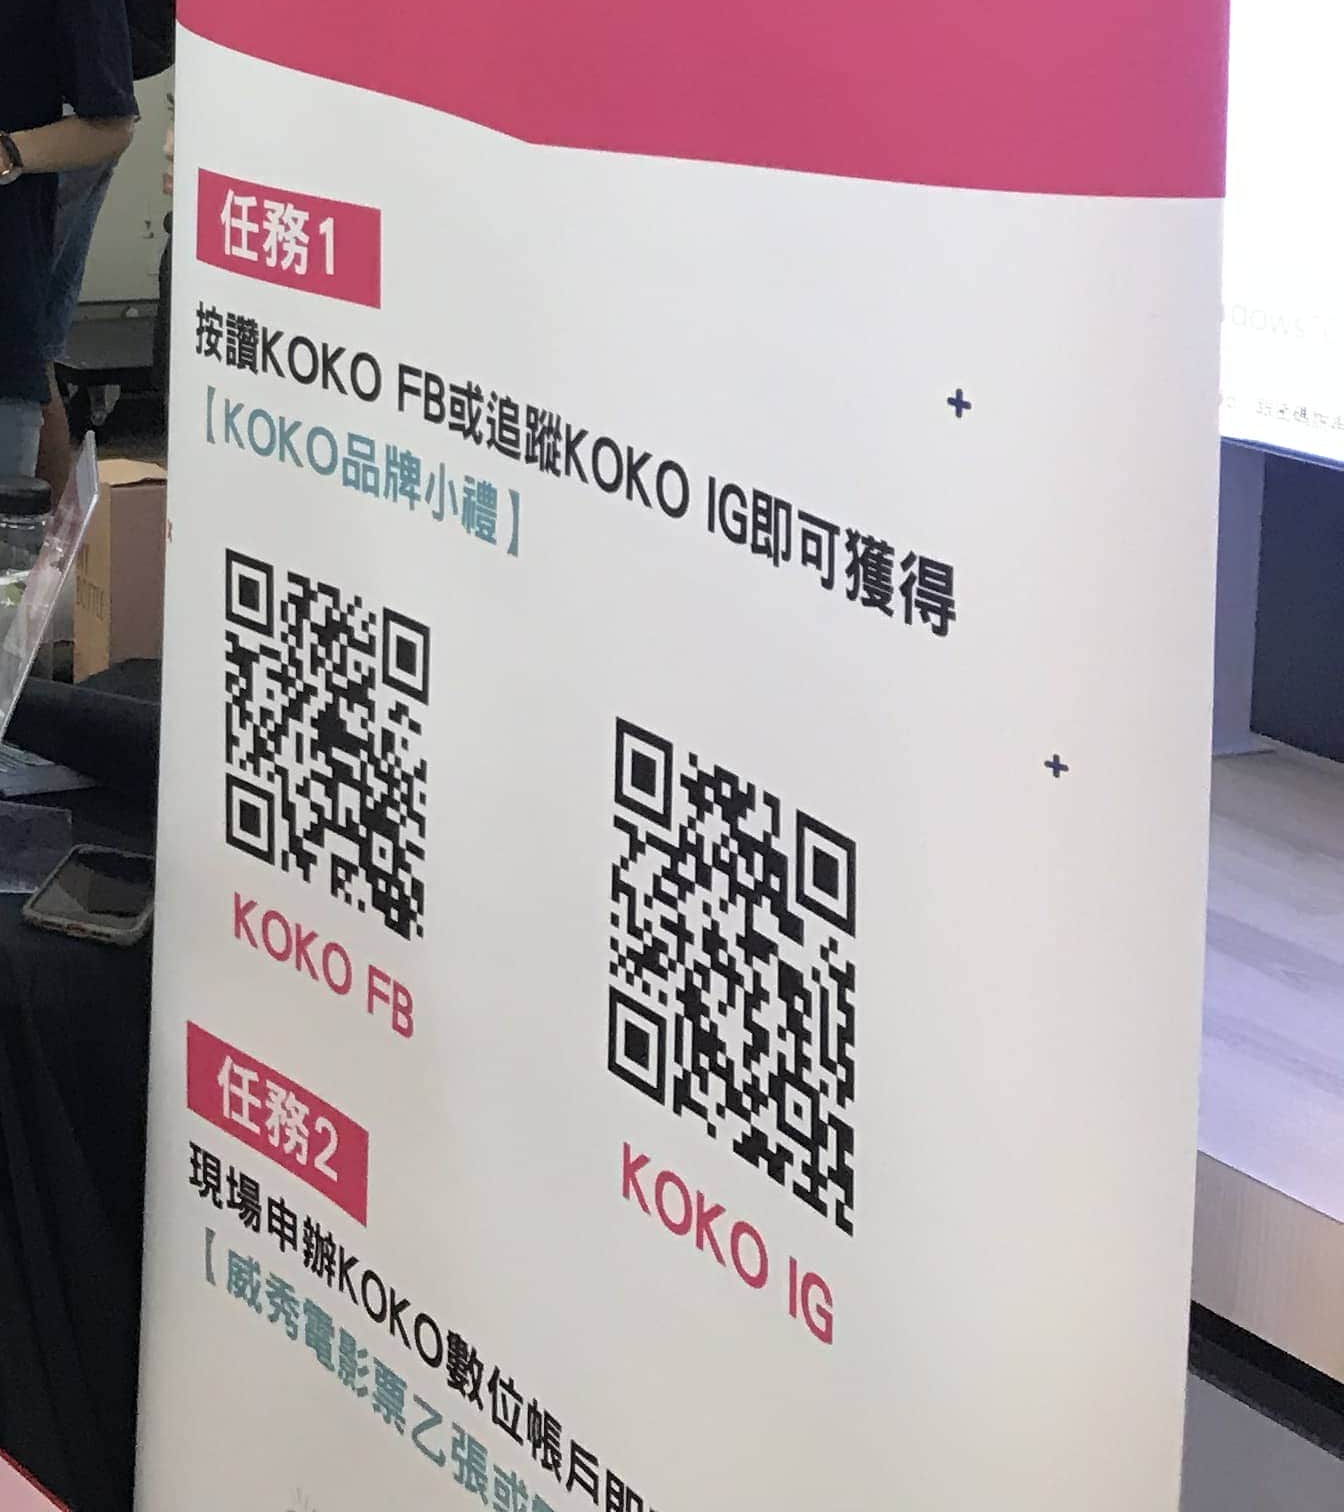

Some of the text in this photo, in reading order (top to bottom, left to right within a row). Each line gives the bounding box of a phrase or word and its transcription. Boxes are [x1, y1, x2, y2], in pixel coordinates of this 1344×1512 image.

[220, 188, 336, 276] 任務1
[194, 300, 383, 403] 按讚KOKO
[707, 474, 958, 638] IG即可獲得
[233, 891, 414, 1039] KOKO FB
[217, 1055, 339, 1183] 任務2
[188, 1141, 662, 1512] 現場申辦KOKO數位帳戶即
[622, 1141, 833, 1345] KOKO IG
[204, 1226, 555, 1512] 【威秀電影票乙張或
